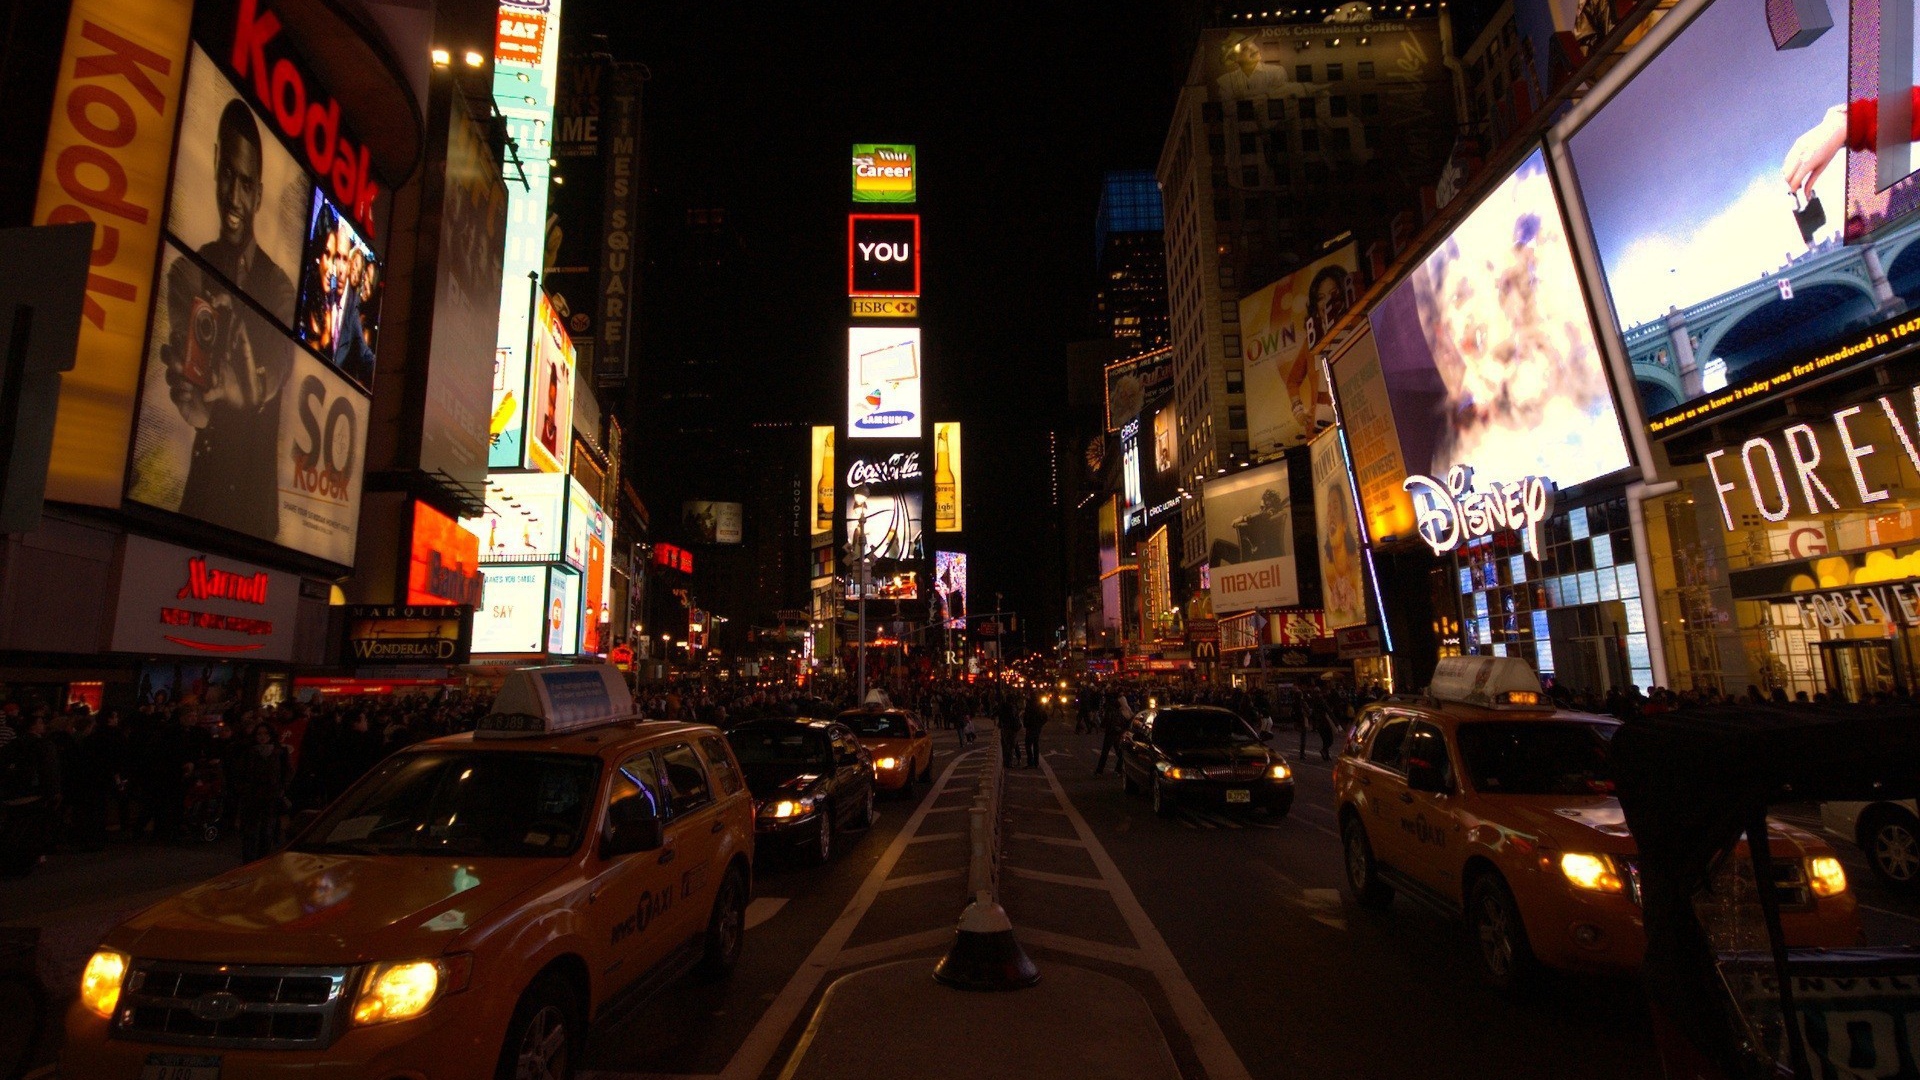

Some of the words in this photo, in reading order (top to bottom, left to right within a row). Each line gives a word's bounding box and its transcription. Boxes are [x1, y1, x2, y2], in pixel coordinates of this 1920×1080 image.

[231, 0, 379, 240] Kodak
[612, 95, 635, 198] TIMES
[857, 164, 911, 178] Career
[858, 243, 909, 261] YOU
[607, 209, 630, 345] SQUARE
[852, 302, 893, 313] HSBC
[1247, 324, 1296, 362] OWN
[1650, 423, 1663, 433] The
[1665, 412, 1686, 428] donut
[1687, 408, 1697, 418] as
[1697, 403, 1711, 414] we
[1710, 396, 1734, 410] know
[1736, 389, 1743, 400] it
[1743, 379, 1770, 398] today
[1771, 371, 1792, 385] was
[1793, 361, 1815, 377] first
[1816, 337, 1873, 367] introduced
[1875, 333, 1888, 345] in
[1891, 318, 1920, 339] 1847
[291, 374, 357, 478] SO
[847, 451, 923, 488] Coca-Cola
[793, 479, 801, 537] NOVOTEL
[177, 557, 269, 605] Marriott
[1220, 564, 1281, 594] maxell
[353, 607, 461, 618] MARQUIS
[493, 605, 514, 619] SAY
[1795, 583, 1920, 630] FOREVE
